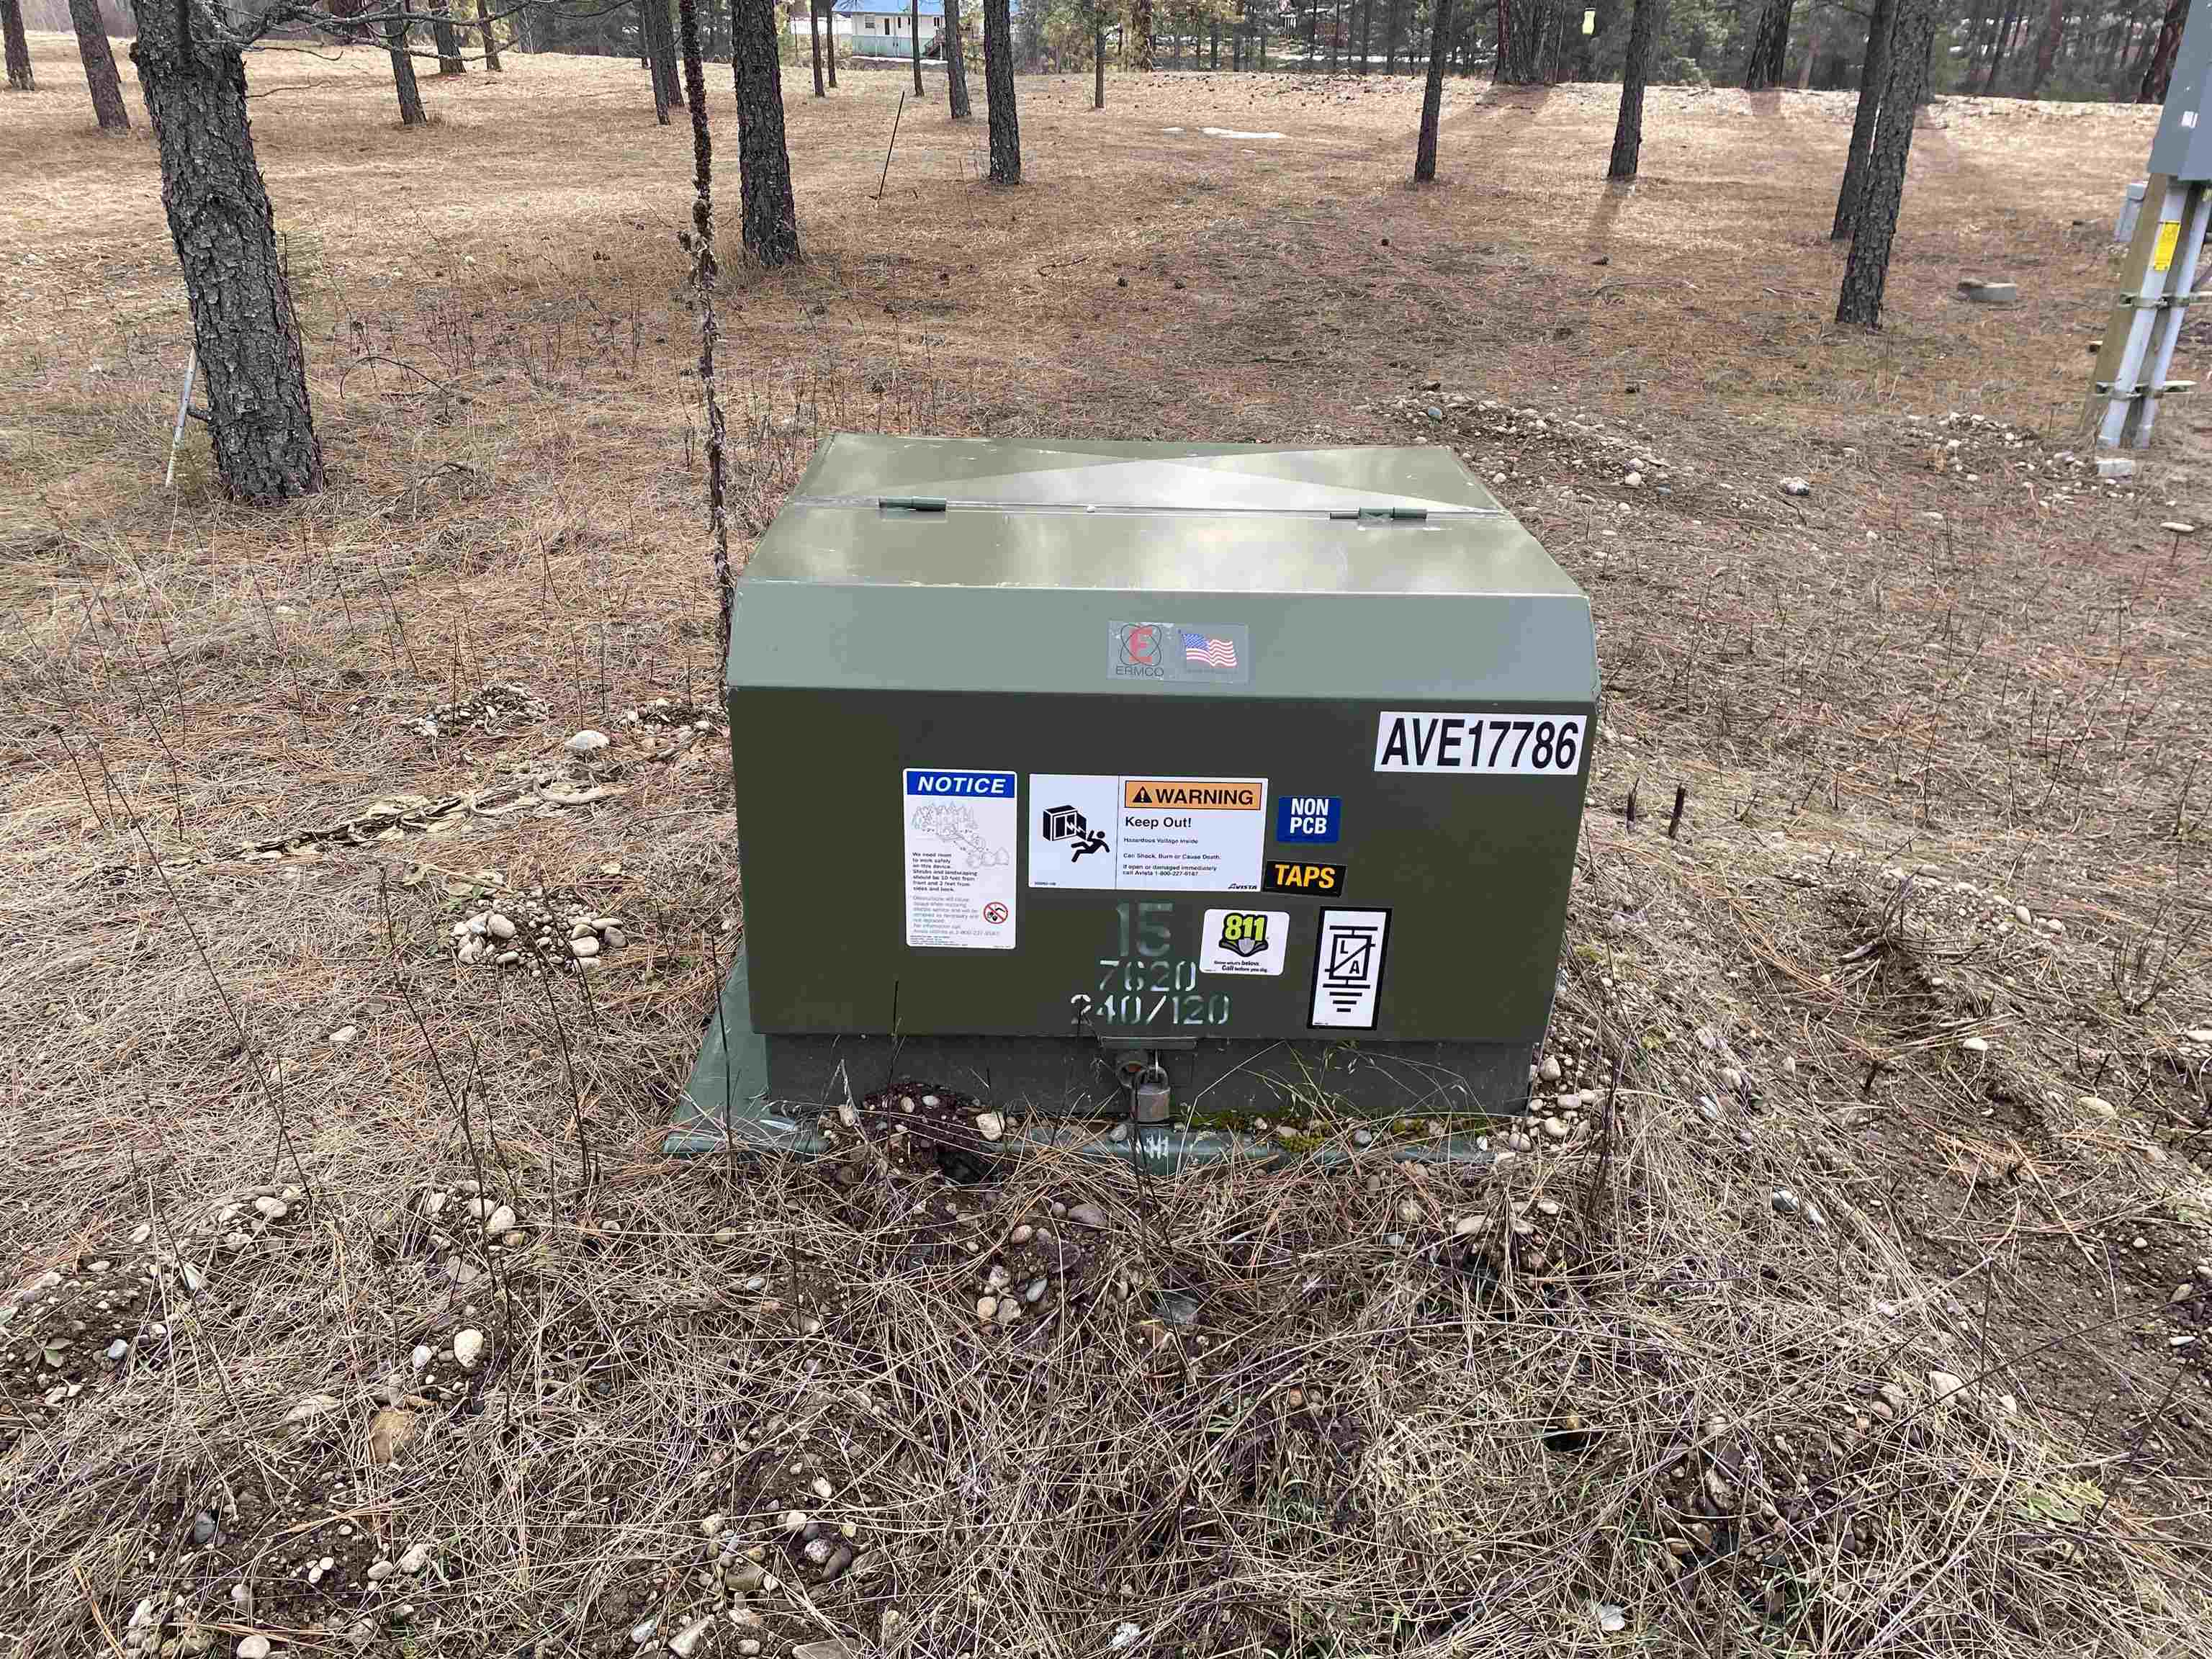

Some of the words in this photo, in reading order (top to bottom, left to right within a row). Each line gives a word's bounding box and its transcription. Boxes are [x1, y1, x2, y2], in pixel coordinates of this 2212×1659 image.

[1116, 665, 1164, 677] ERMCO
[1380, 717, 1579, 769] AVE17786
[917, 775, 1006, 793] NOTICE
[1155, 788, 1254, 805] WARNING
[1291, 798, 1329, 816] NON
[1125, 817, 1159, 829] Keep
[1163, 817, 1192, 827] Out!
[1290, 817, 1327, 835] PCB
[1274, 864, 1336, 889] TAPS
[1116, 902, 1174, 957] 15
[1223, 913, 1267, 941] 811
[1340, 940, 1349, 954] L
[1100, 960, 1196, 992] 7620
[1349, 960, 1360, 974] A
[1071, 994, 1228, 1025] 240/120
